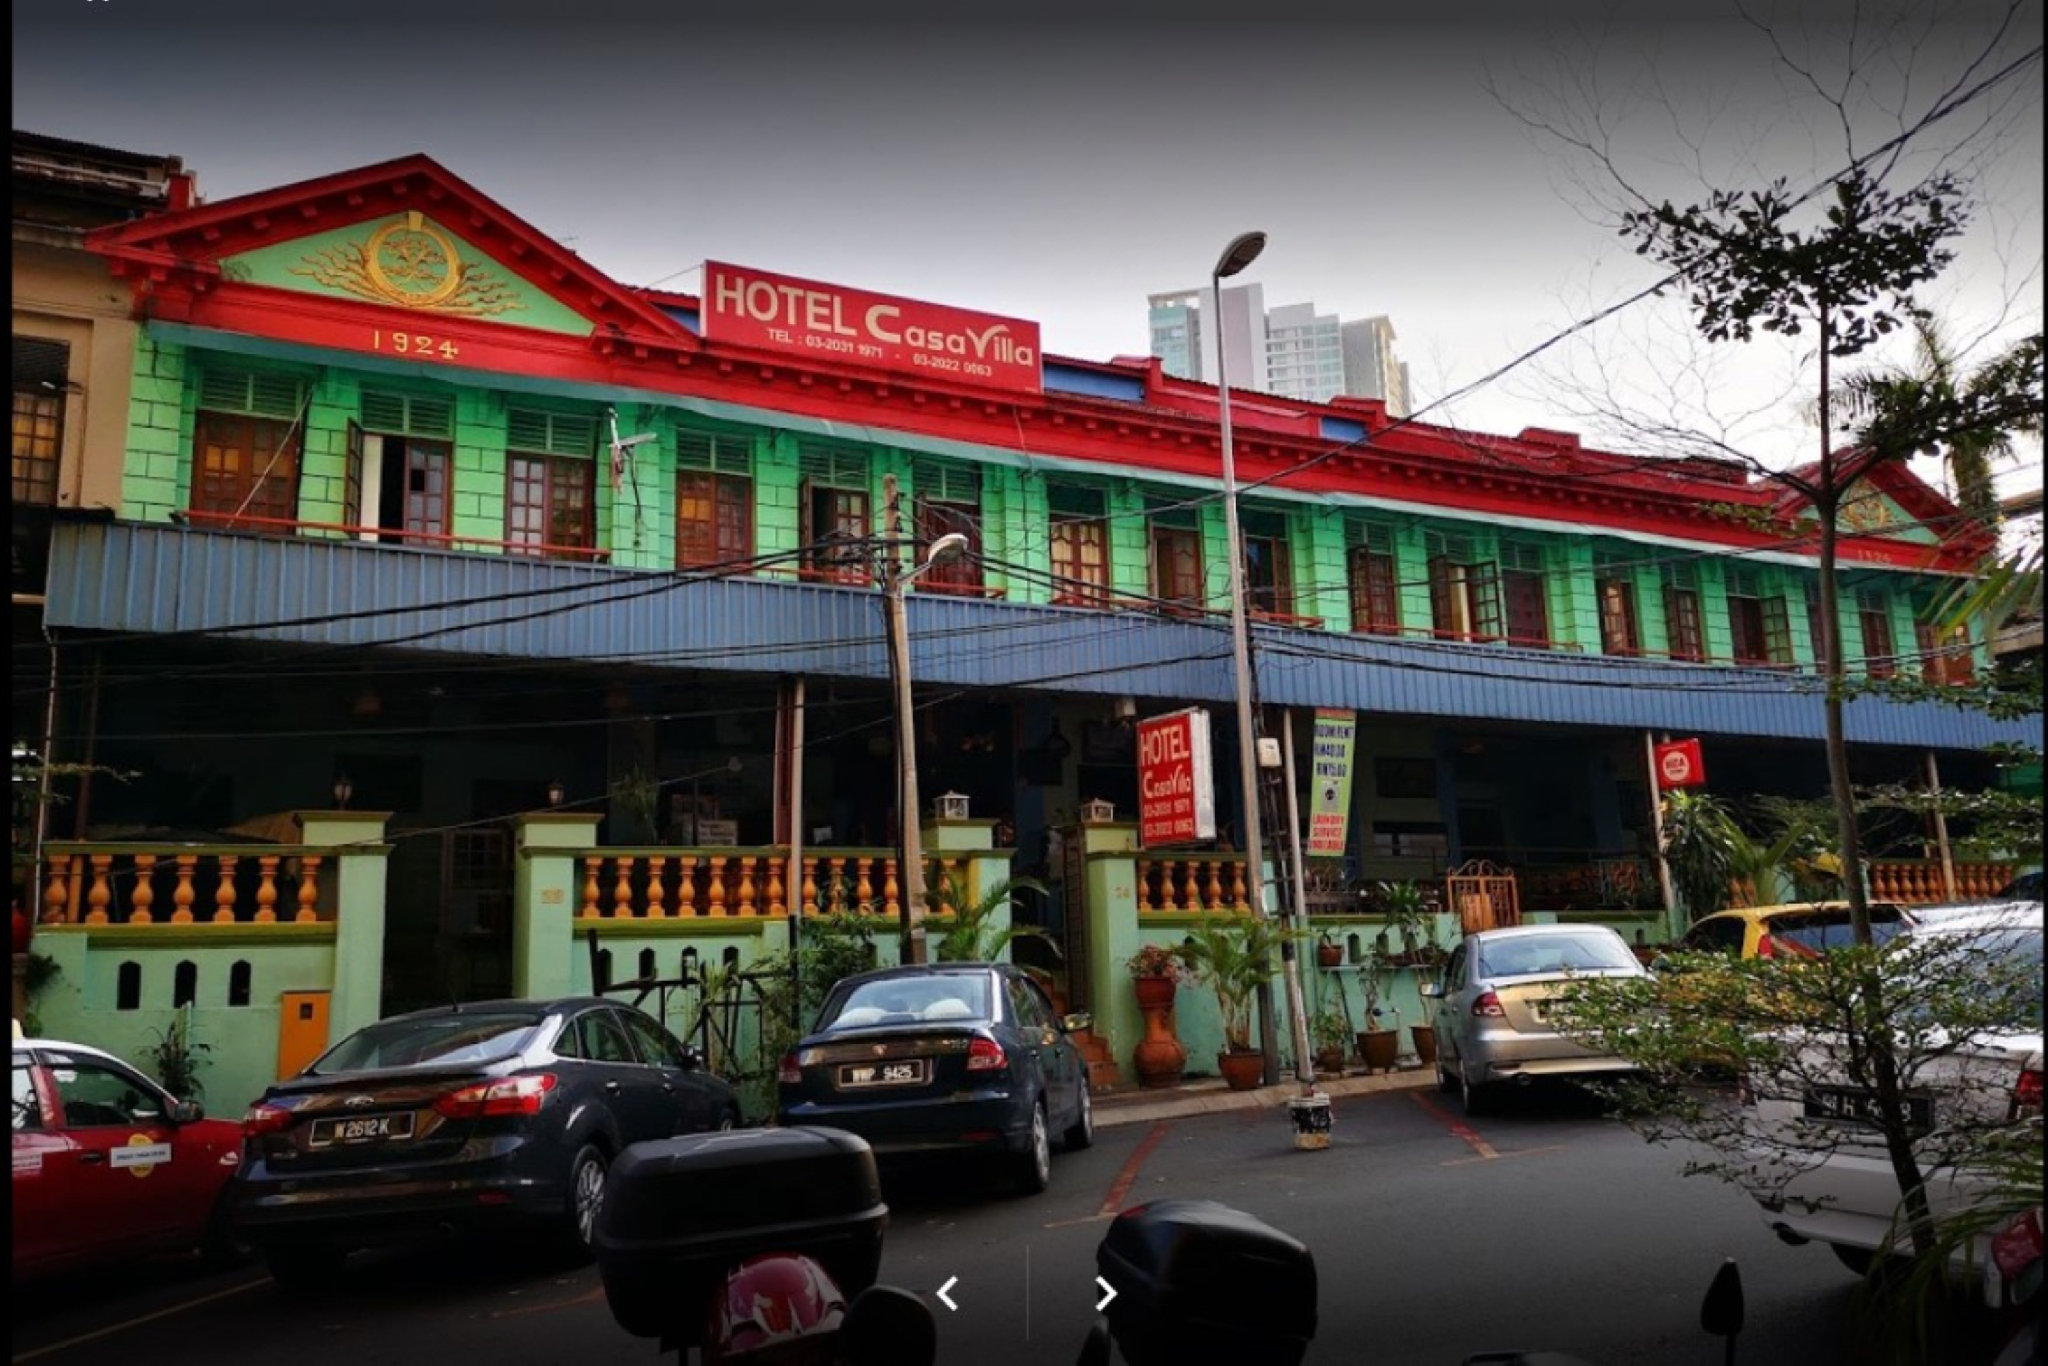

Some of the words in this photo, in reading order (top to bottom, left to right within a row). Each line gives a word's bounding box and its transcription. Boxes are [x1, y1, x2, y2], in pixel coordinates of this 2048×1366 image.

[716, 273, 858, 337] HOTEL
[374, 330, 459, 360] 1924
[768, 327, 793, 344] TEL
[1140, 724, 1190, 766] HOTEL
